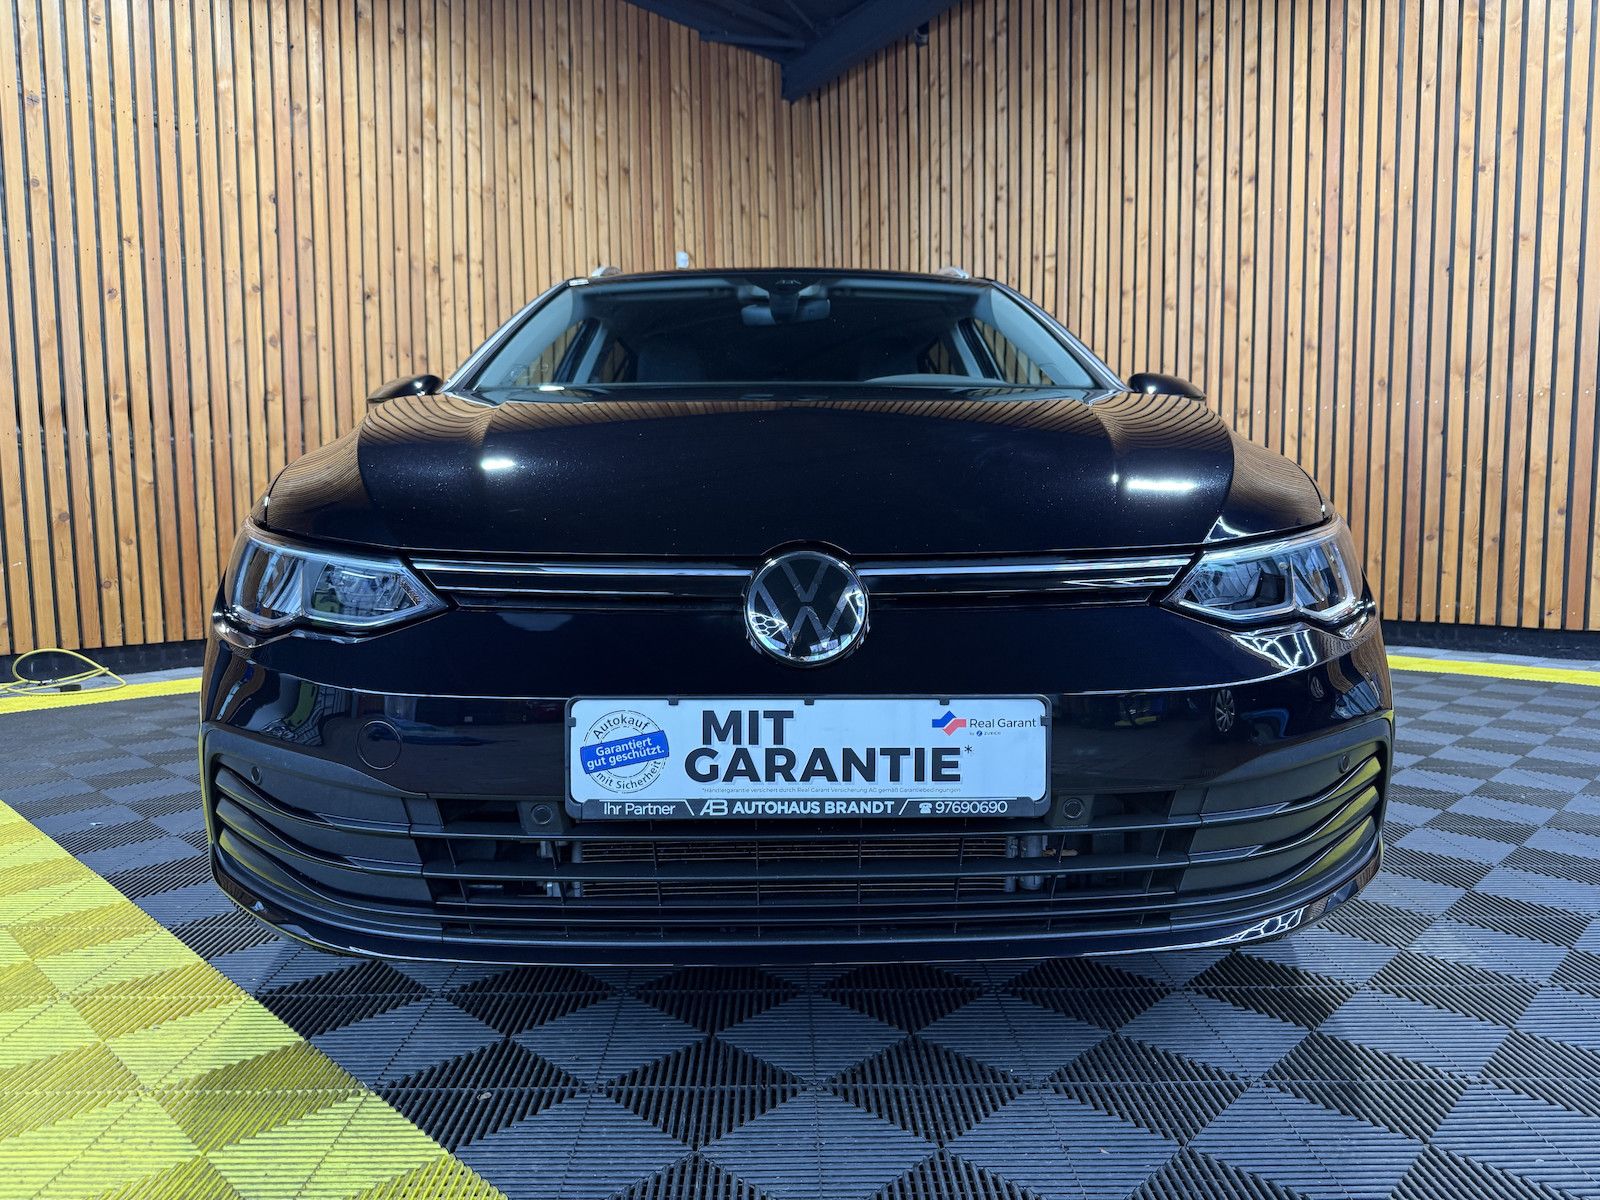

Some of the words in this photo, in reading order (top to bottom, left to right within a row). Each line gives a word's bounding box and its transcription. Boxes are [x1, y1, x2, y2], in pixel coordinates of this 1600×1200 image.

[593, 713, 651, 739] Autokauf
[702, 710, 794, 745] MIT
[969, 718, 995, 728] Real
[997, 718, 1036, 728] Garant
[595, 736, 653, 756] Garantiert
[586, 755, 607, 771] gut
[608, 745, 665, 766] geschützt.
[596, 772, 613, 787] mit
[616, 760, 661, 790] Sicherheit
[604, 802, 622, 815] Ihr
[625, 802, 676, 815] Partner
[732, 801, 821, 814] AUTOHAUS
[824, 801, 895, 814] BRANDT
[935, 801, 1008, 814] 97690690
